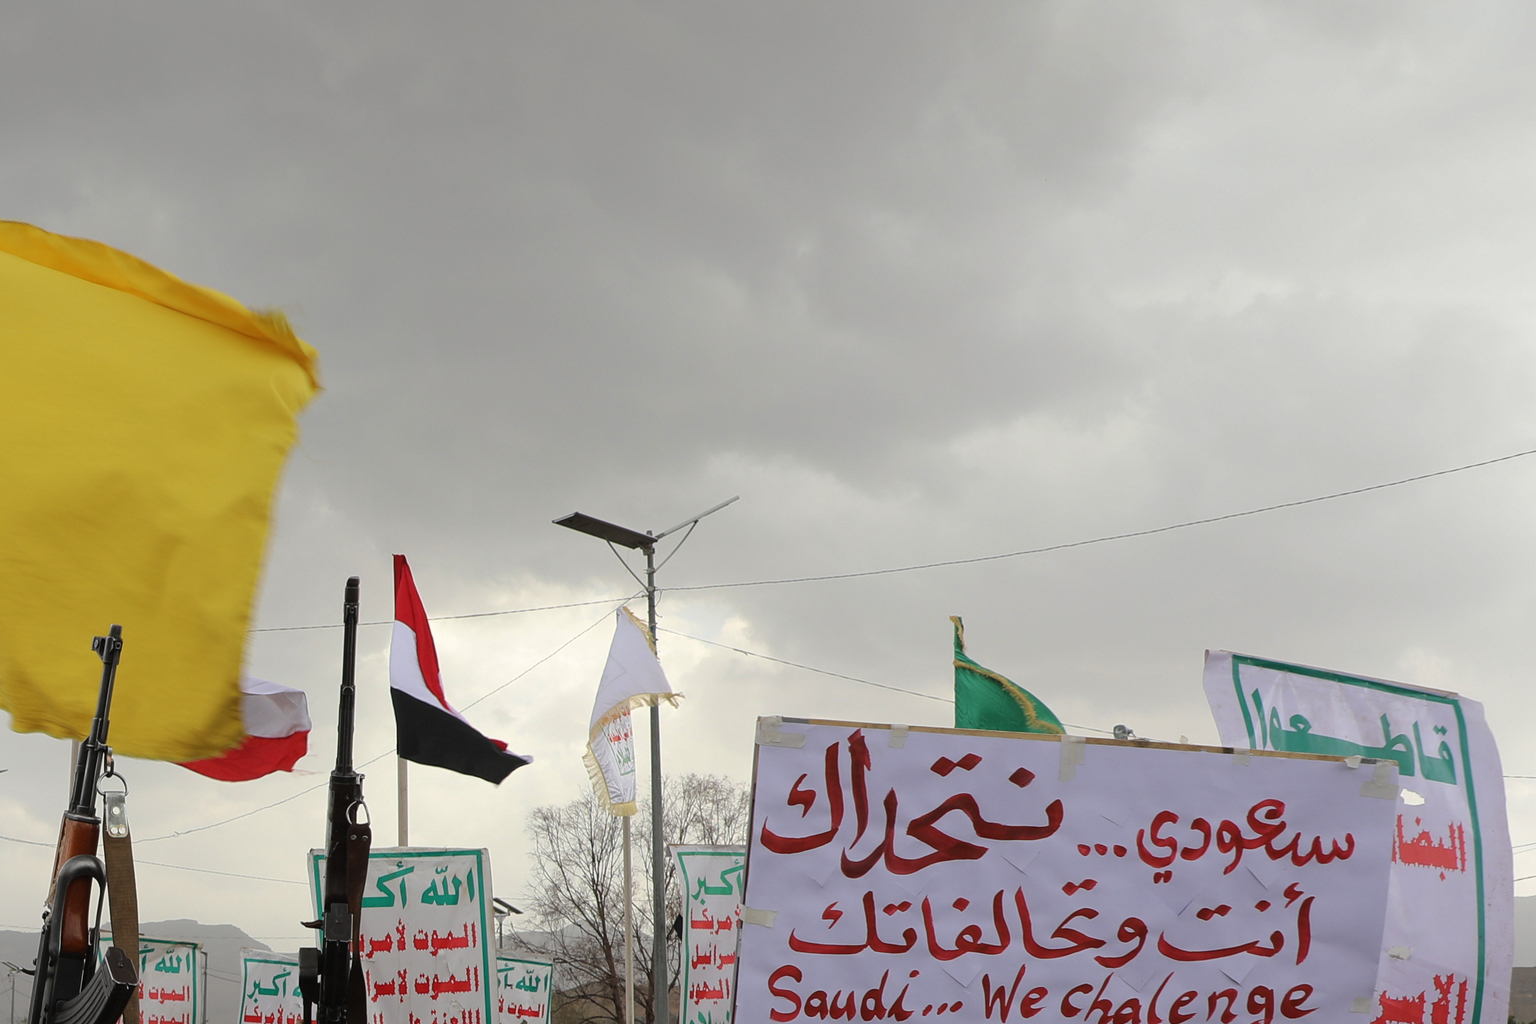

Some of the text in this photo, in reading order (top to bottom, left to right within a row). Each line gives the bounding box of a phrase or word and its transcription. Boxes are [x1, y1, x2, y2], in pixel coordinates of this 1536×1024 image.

[1391, 813, 1466, 881] البضا
[361, 861, 476, 910] الله أك
[413, 921, 477, 957] الموت
[1157, 882, 1316, 966] أنت
[154, 948, 190, 974] الله
[691, 943, 736, 970] سرائيل
[148, 985, 190, 1005] الموت
[247, 966, 292, 1003] أكبر
[366, 967, 408, 1003] لإسرا
[414, 964, 480, 1001] الموت
[515, 969, 549, 994] الله
[689, 977, 730, 1005] اليهود
[767, 964, 963, 1022] Saudi...
[982, 964, 1048, 1024] We
[507, 1002, 546, 1020] الموت
